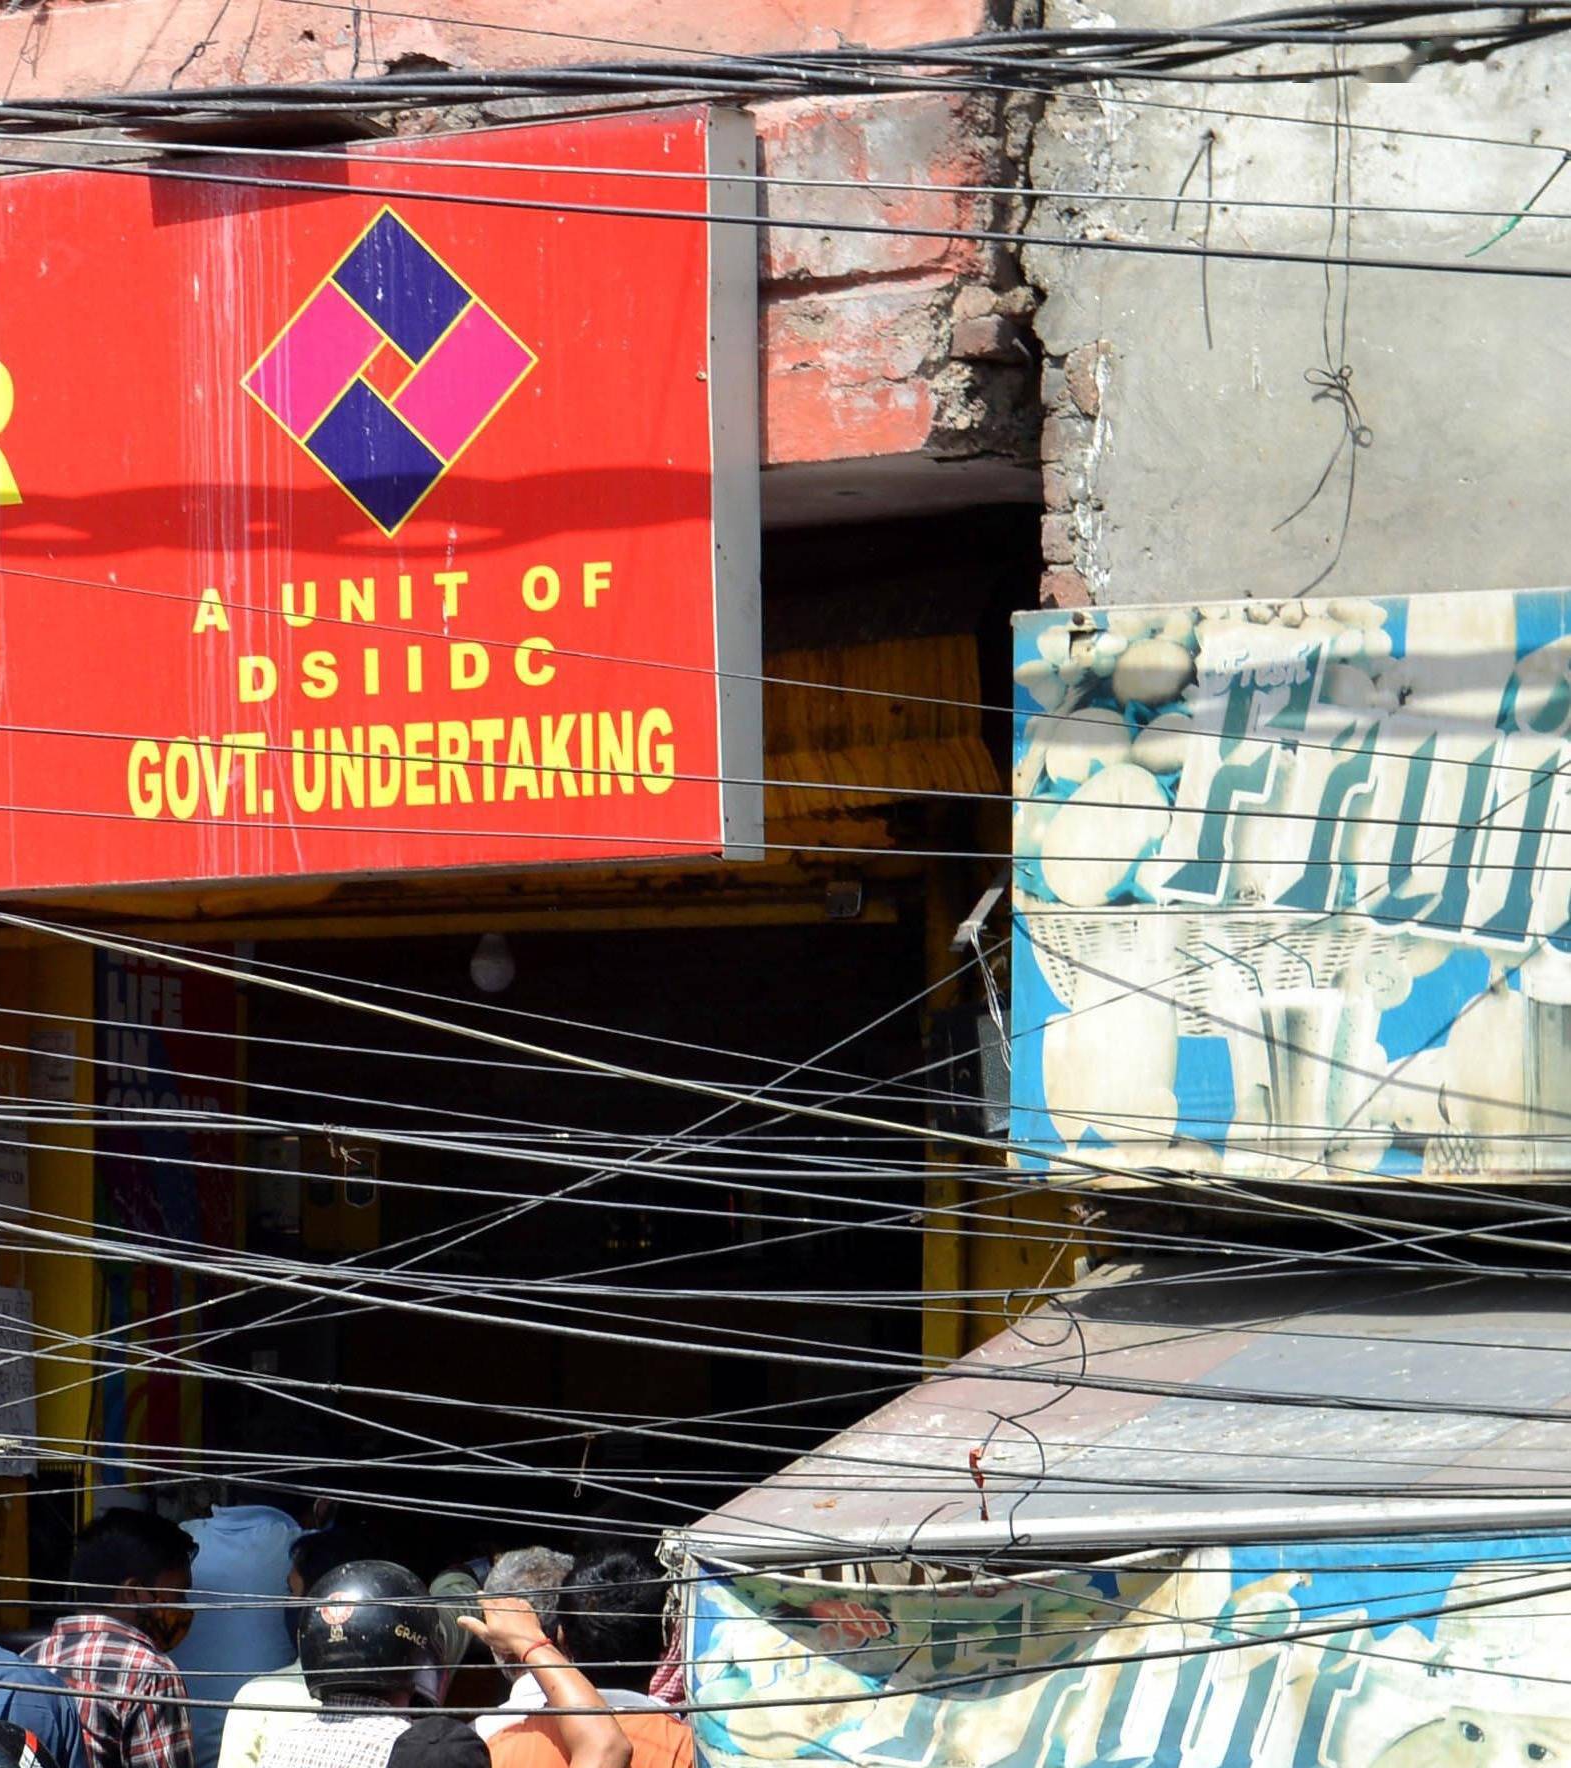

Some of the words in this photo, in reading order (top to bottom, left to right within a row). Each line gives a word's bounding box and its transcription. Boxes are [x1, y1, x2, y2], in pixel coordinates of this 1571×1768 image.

[192, 588, 230, 634] A
[281, 571, 469, 628] UNIT
[521, 560, 613, 612] OF
[127, 730, 275, 821] GOVT.
[291, 706, 677, 812] UNDERTAKING
[106, 970, 184, 1029] LIFE
[106, 1028, 150, 1085] IN
